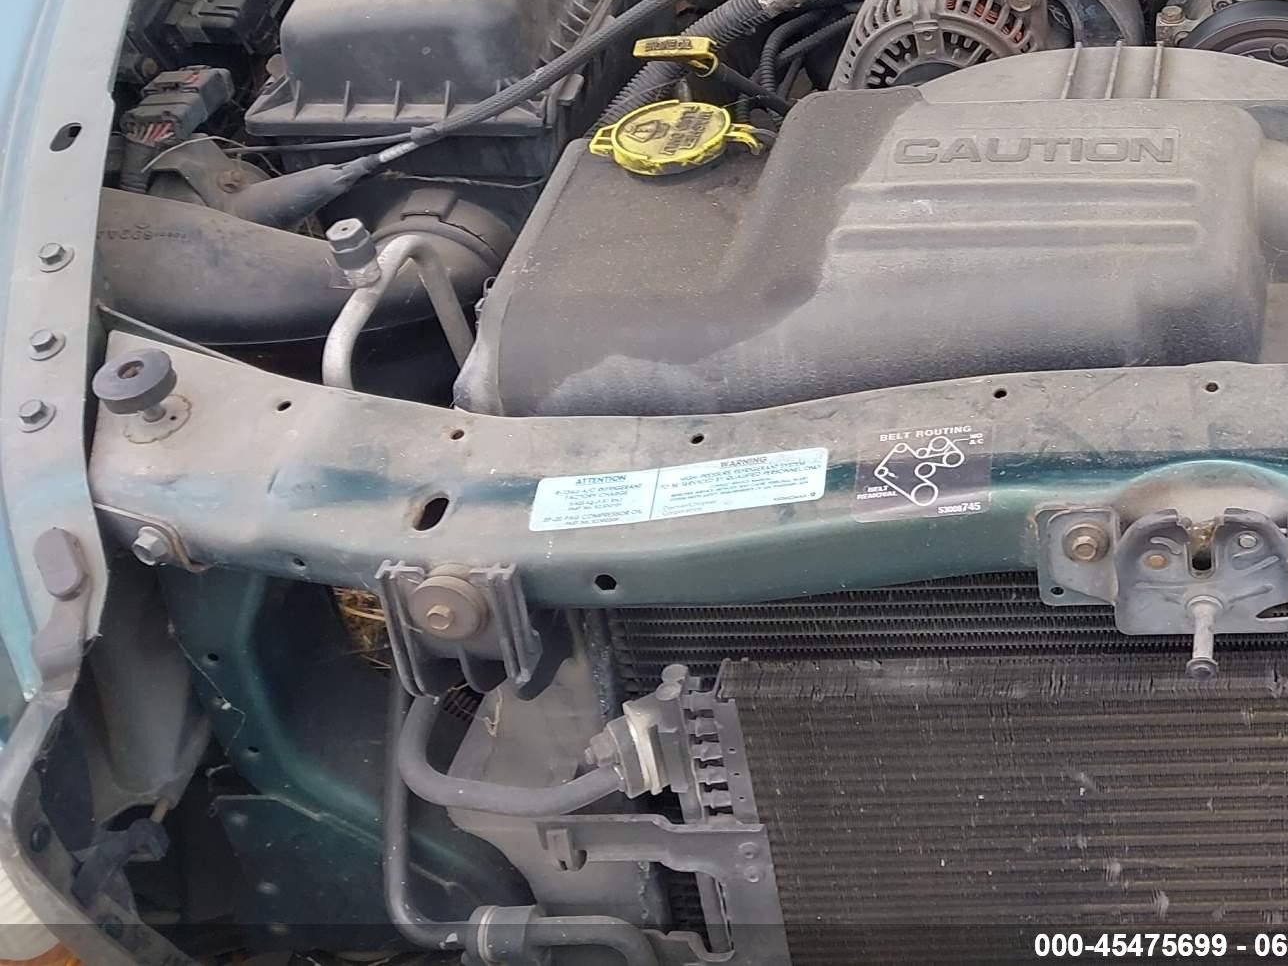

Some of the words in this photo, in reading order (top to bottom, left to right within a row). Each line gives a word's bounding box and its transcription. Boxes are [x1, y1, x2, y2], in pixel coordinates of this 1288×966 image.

[894, 136, 1174, 163] CAUTION
[879, 432, 912, 442] BELT
[916, 425, 972, 438] ROUTING
[720, 456, 767, 468] WARNING
[576, 474, 627, 486] ATTENTION
[856, 490, 898, 500] REMOVAL
